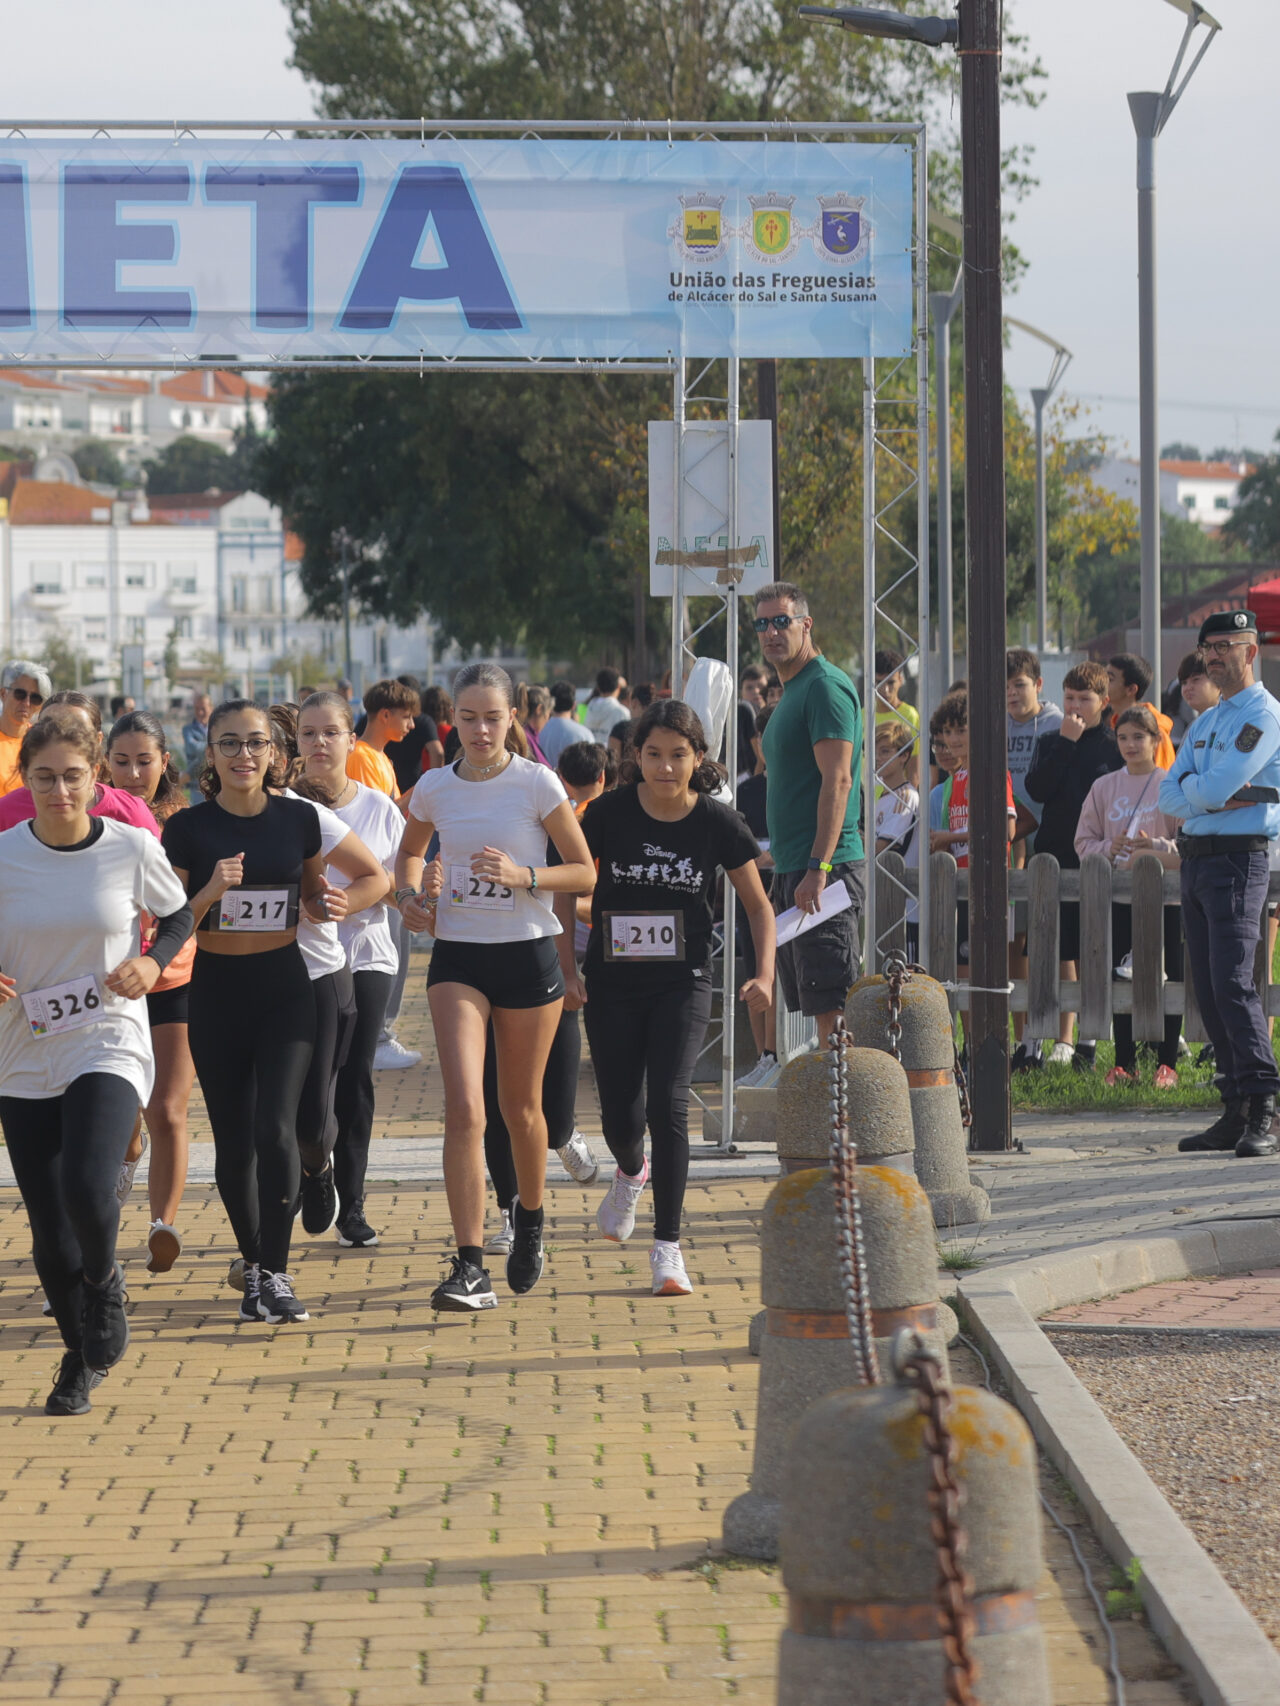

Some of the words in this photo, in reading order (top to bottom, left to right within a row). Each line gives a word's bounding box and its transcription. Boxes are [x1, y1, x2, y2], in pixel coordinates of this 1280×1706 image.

[670, 271, 726, 287] União
[732, 272, 765, 287] das
[772, 272, 876, 291] Freguesias
[668, 290, 683, 301] de
[687, 290, 735, 302] Alcácer
[739, 290, 754, 302] do
[758, 291, 776, 302] Sal
[780, 293, 787, 302] e
[790, 291, 827, 302] Santa
[830, 291, 877, 302] Susana
[643, 843, 677, 862] Disney
[240, 900, 286, 919] 217
[630, 926, 674, 945] 210
[47, 987, 100, 1020] 326
